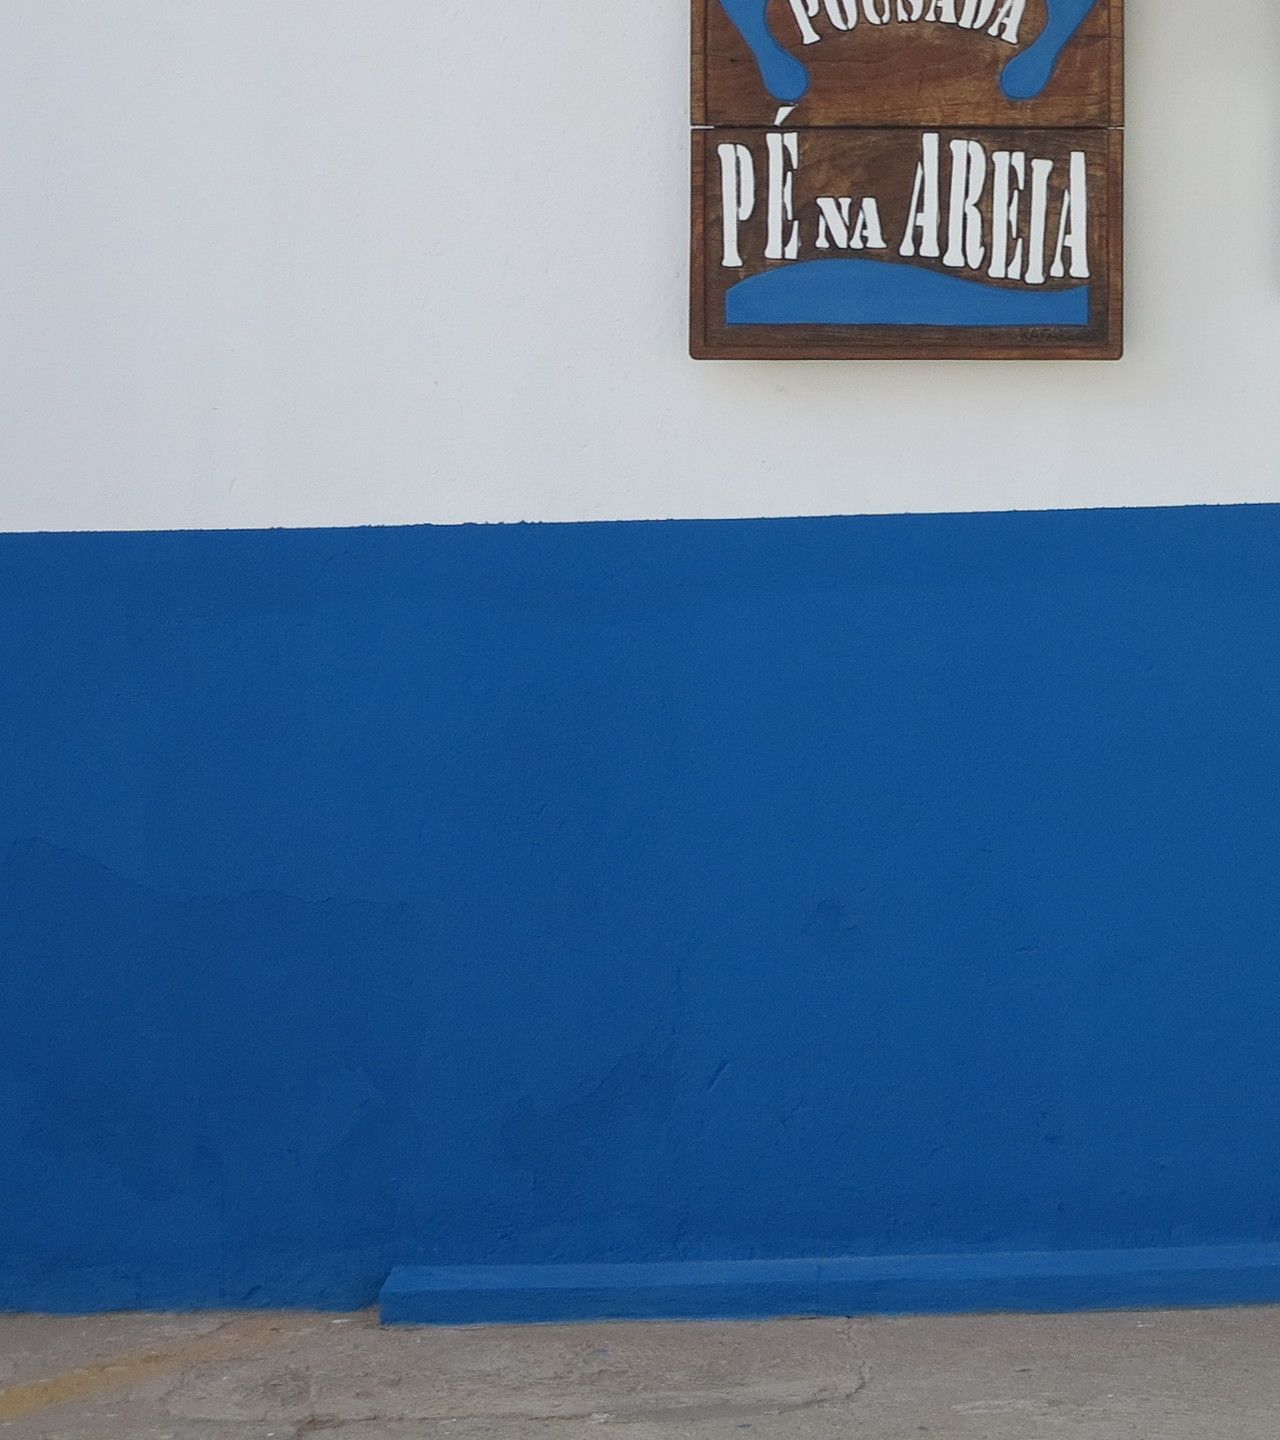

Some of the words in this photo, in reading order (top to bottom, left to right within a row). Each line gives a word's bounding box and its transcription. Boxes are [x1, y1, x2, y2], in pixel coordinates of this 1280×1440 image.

[717, 103, 799, 268] PÉ
[815, 196, 888, 250] NA
[899, 132, 1091, 285] AREIA
